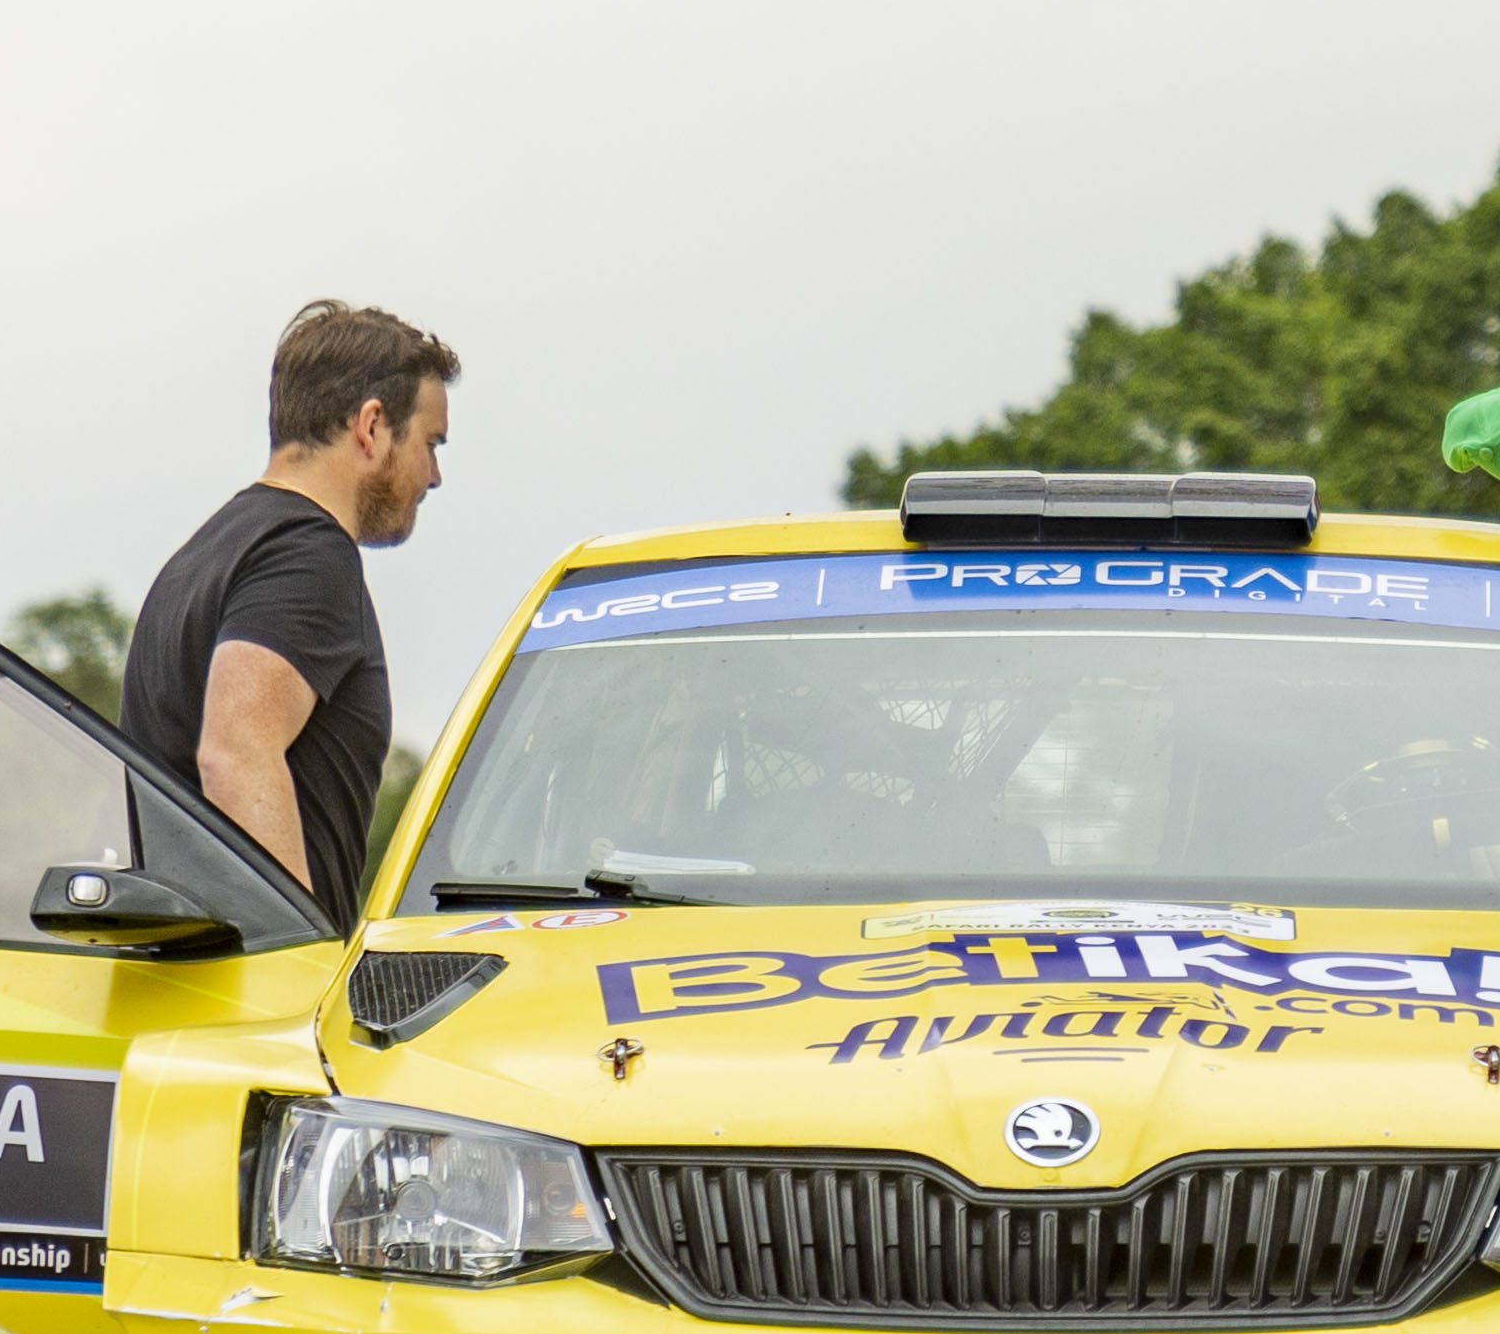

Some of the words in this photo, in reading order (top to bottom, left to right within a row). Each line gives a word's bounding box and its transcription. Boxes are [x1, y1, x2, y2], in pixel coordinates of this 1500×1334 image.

[527, 576, 781, 631] WRC2
[1165, 584, 1428, 610] DIGITAL
[1255, 993, 1498, 1027] .com
[808, 1005, 1326, 1063] Aviator
